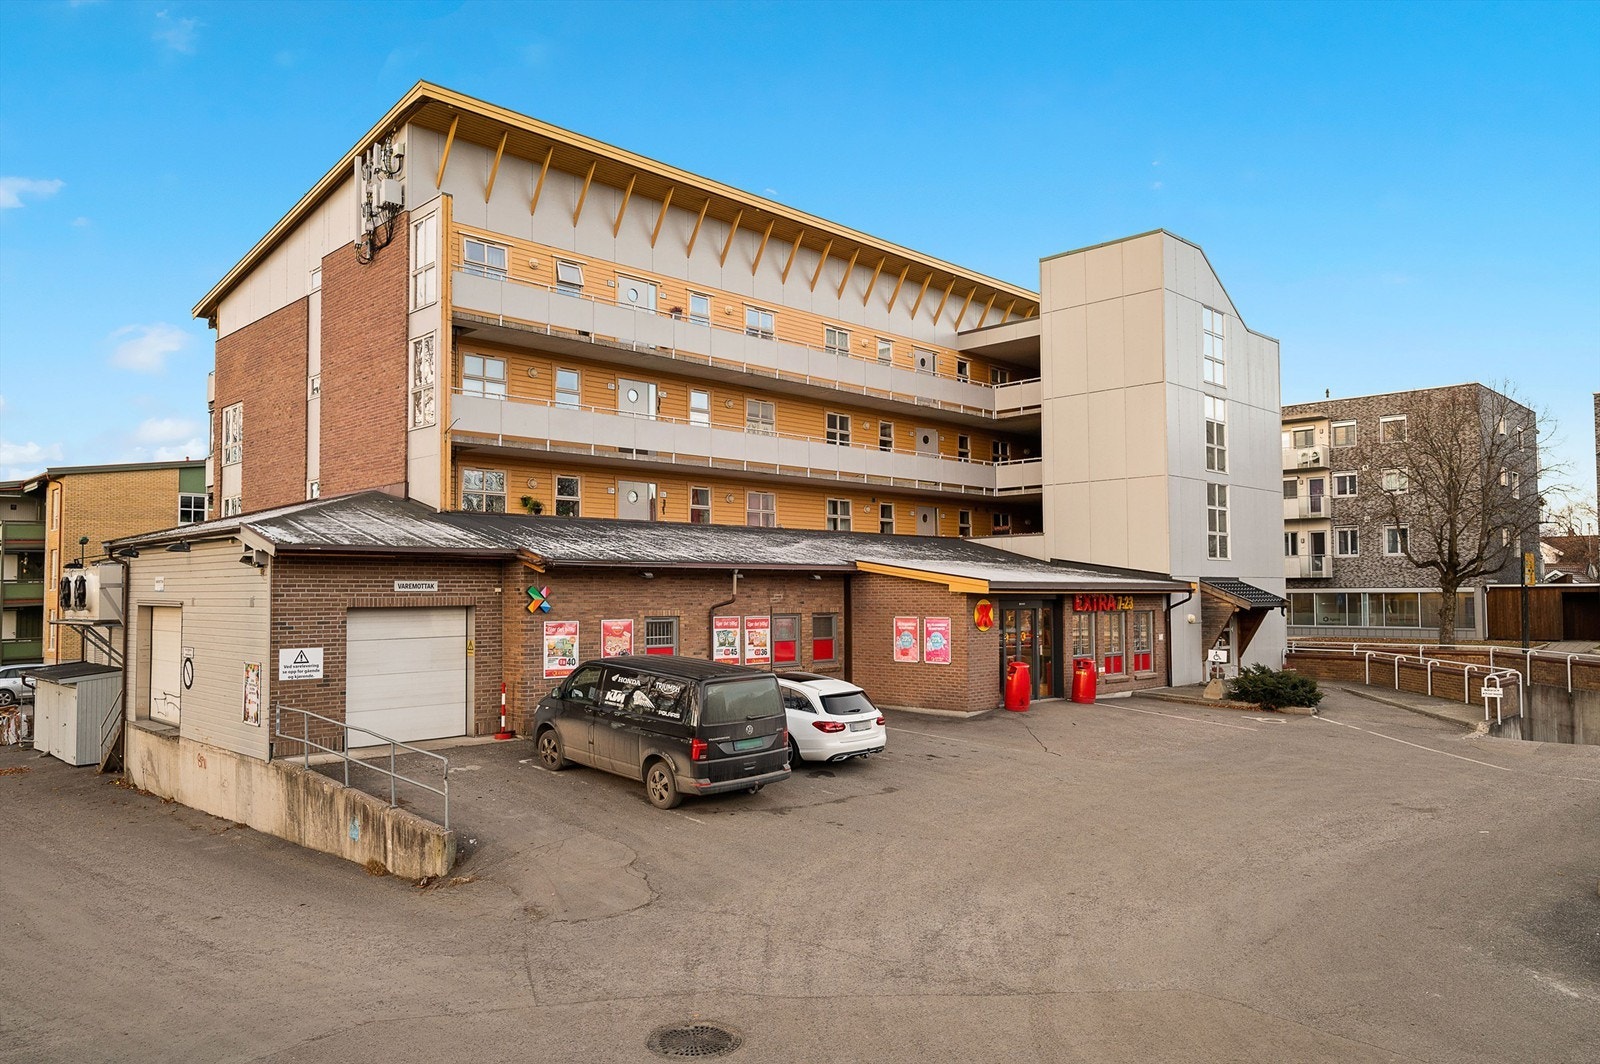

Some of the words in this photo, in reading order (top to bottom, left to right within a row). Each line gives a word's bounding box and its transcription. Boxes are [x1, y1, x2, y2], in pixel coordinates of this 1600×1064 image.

[1073, 593, 1116, 611] EXTRA
[1117, 596, 1134, 610] 7-23
[730, 648, 738, 656] 45
[760, 648, 768, 656] 36
[566, 657, 576, 666] 40
[617, 676, 641, 686] HONDA
[655, 682, 681, 693] TRIUMPH
[605, 689, 626, 704] KTM
[658, 709, 680, 719] POLARIS
